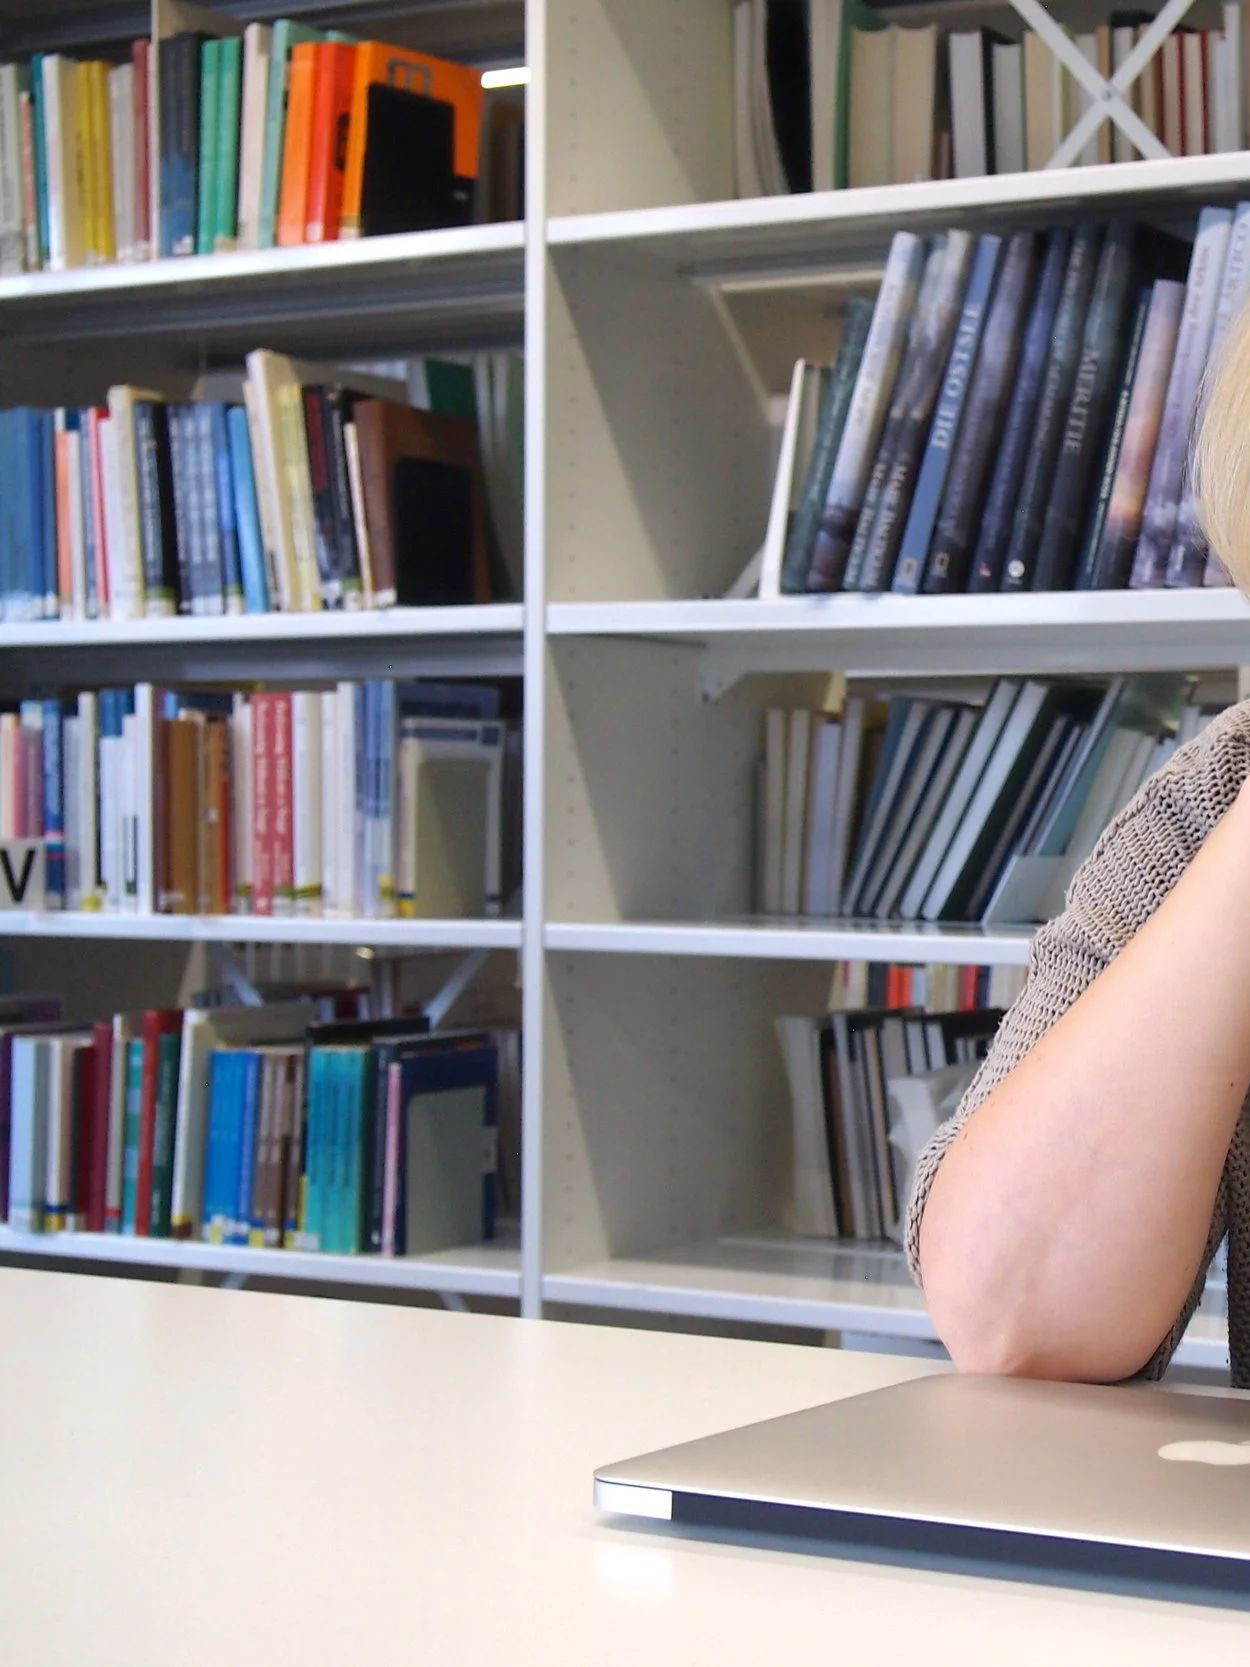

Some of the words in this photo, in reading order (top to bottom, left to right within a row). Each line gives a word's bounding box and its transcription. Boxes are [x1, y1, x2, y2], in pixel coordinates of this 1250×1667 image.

[942, 304, 982, 398] OSTSEE
[929, 403, 957, 448] DIE
[0, 846, 36, 904] V
